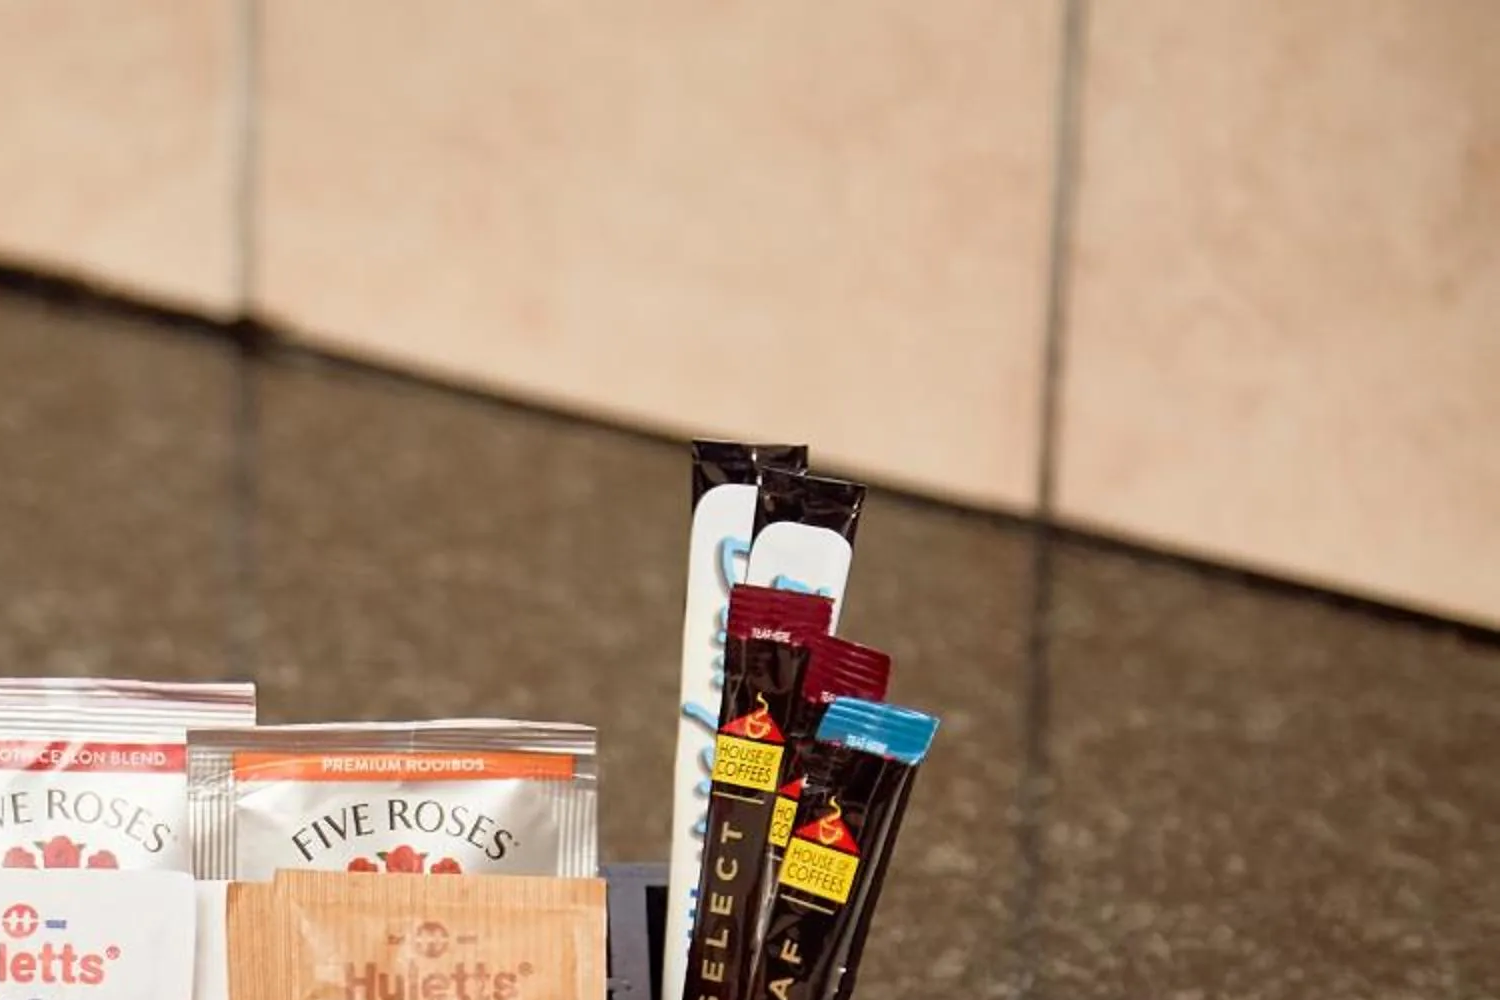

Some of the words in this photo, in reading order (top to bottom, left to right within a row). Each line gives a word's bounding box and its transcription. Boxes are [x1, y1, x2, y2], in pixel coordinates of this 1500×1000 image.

[39, 748, 106, 765] CELON
[110, 750, 168, 767] BLEND
[321, 757, 402, 773] PREMIUM
[406, 757, 485, 773] ROOIBOS
[719, 741, 764, 765] HOUSE
[715, 759, 772, 785] COFFEES
[46, 788, 172, 854] ROSES
[291, 802, 375, 863] FIVE
[387, 798, 514, 861] ROSES
[790, 847, 836, 873] HOUSE
[786, 861, 848, 895] COFFEES
